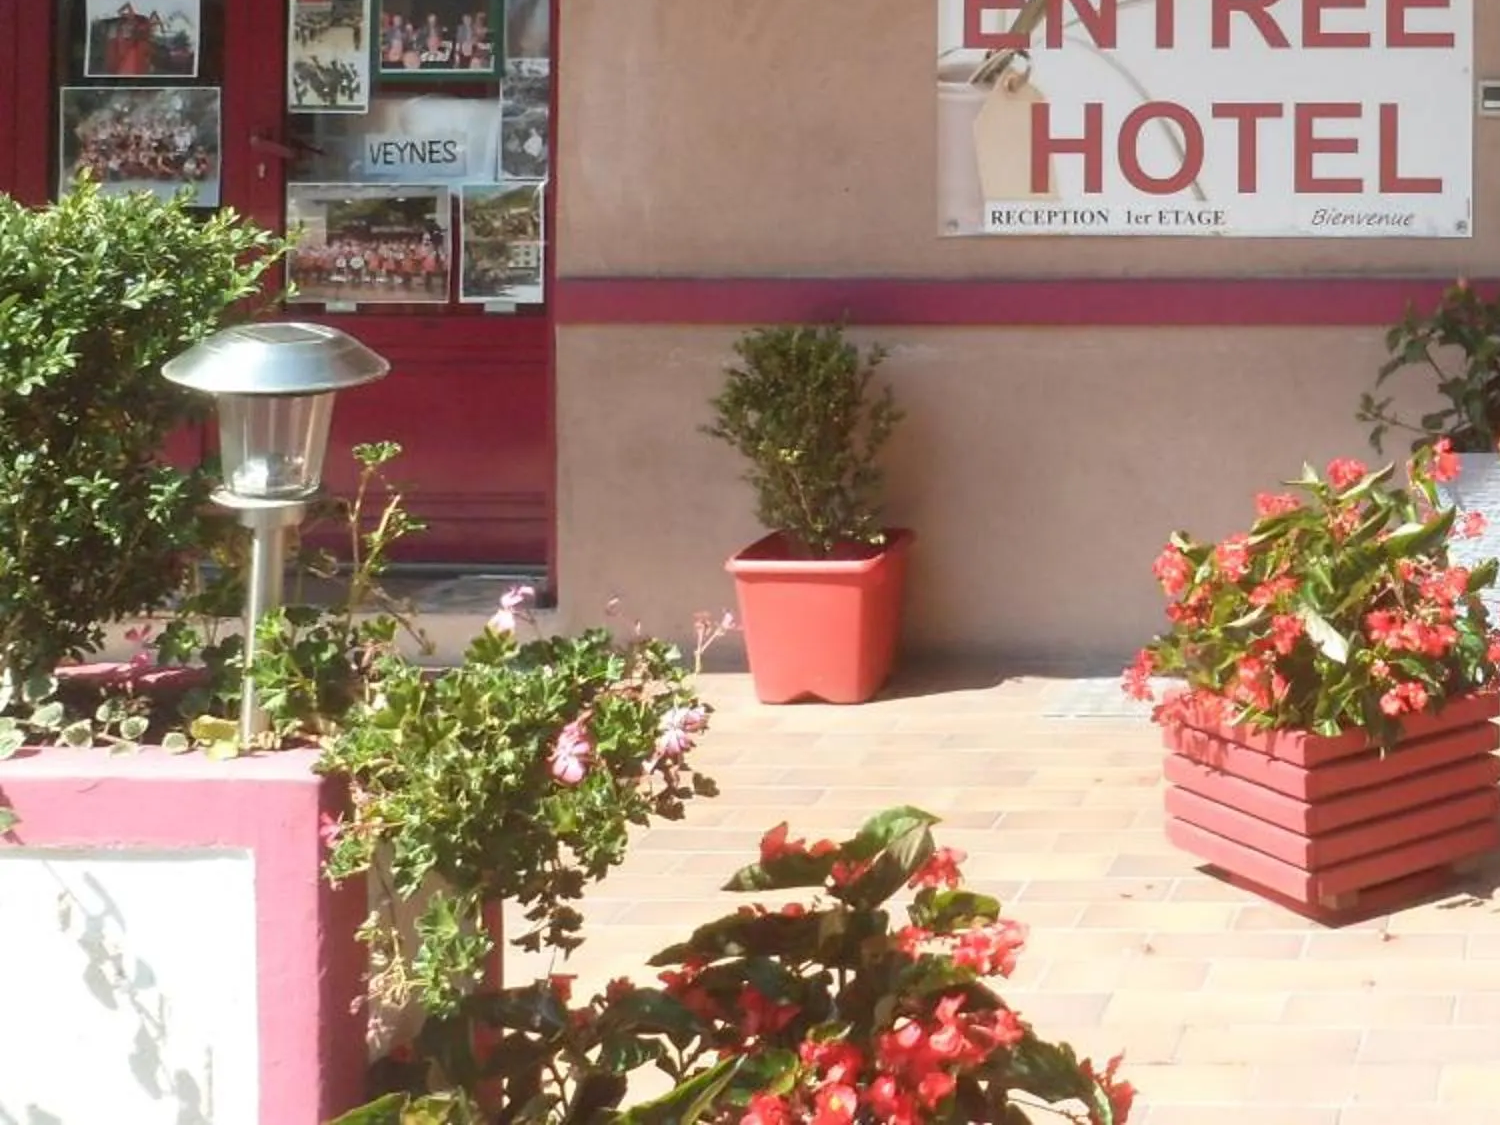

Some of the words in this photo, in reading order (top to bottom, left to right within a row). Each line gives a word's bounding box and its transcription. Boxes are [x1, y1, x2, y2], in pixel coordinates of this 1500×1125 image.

[369, 139, 458, 166] VEYNES
[1030, 100, 1443, 194] HOTEL
[991, 209, 1110, 226] RECEPTION
[1126, 210, 1152, 226] 1er
[1158, 210, 1226, 226] ETAGE
[1311, 207, 1416, 227] Bienvenue
